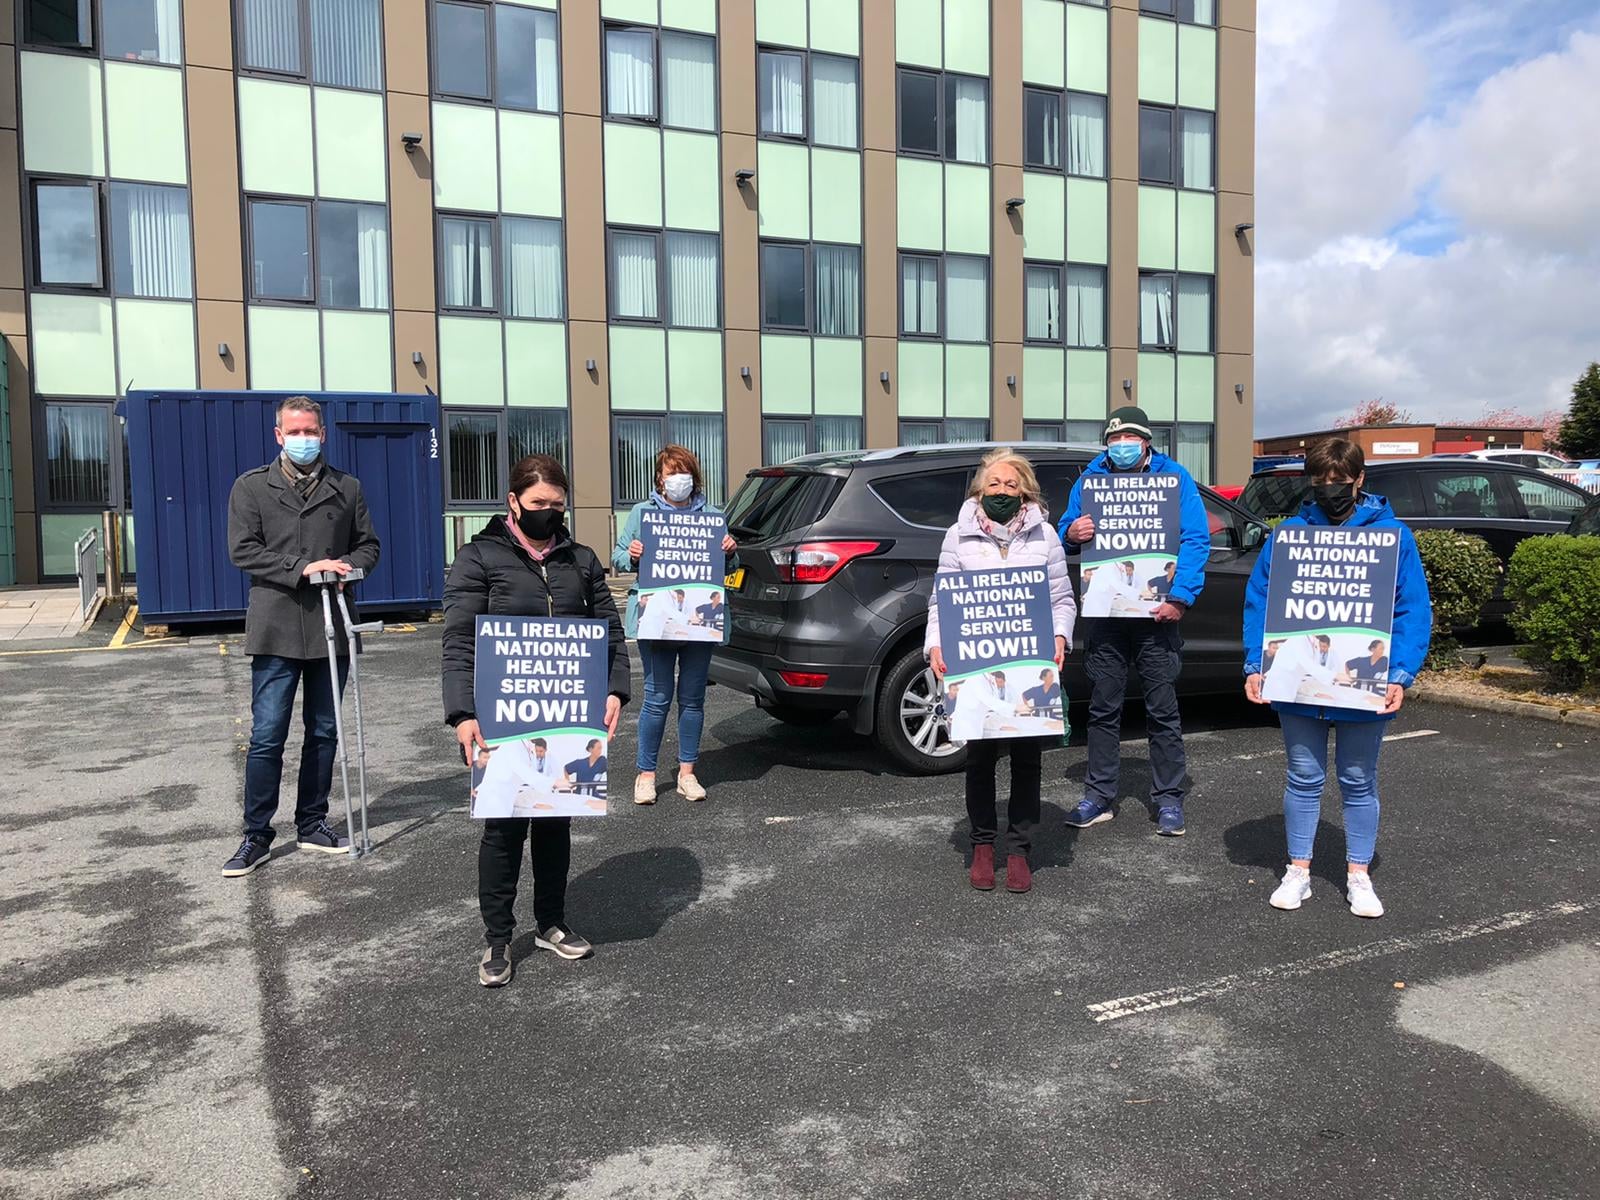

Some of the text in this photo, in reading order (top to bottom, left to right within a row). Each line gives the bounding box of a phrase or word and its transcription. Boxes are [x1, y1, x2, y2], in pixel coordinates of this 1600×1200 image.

[1082, 476, 1179, 490] ALL IRELAND
[1094, 489, 1168, 503] NATIONAL
[1102, 503, 1159, 517] HEALTH
[642, 512, 725, 527] ALL IRELAND
[1098, 517, 1163, 530] SERVICE
[651, 524, 715, 539] NATIONAL
[1275, 529, 1397, 547] ALL IRELAND
[658, 537, 707, 551] HEALTH
[1095, 532, 1166, 551] NOW!!
[655, 549, 711, 563] SERVICE
[1288, 546, 1380, 564] NATIONAL
[651, 562, 713, 581] NOW!!
[937, 570, 1046, 591] ALL IRELAND
[1296, 563, 1368, 580] HEALTH
[951, 586, 1036, 606] NATIONAL
[1290, 579, 1372, 598] SERVICE
[962, 602, 1027, 621] HEALTH
[1284, 597, 1375, 624] NOW!!
[479, 621, 606, 640] ALL IRELAND
[959, 618, 1033, 637] SERVICE
[494, 639, 592, 658] NATIONAL
[957, 635, 1039, 661] NOW!!
[505, 658, 580, 676] HEALTH
[499, 678, 586, 695] SERVICE
[495, 698, 589, 723] NOW!!
